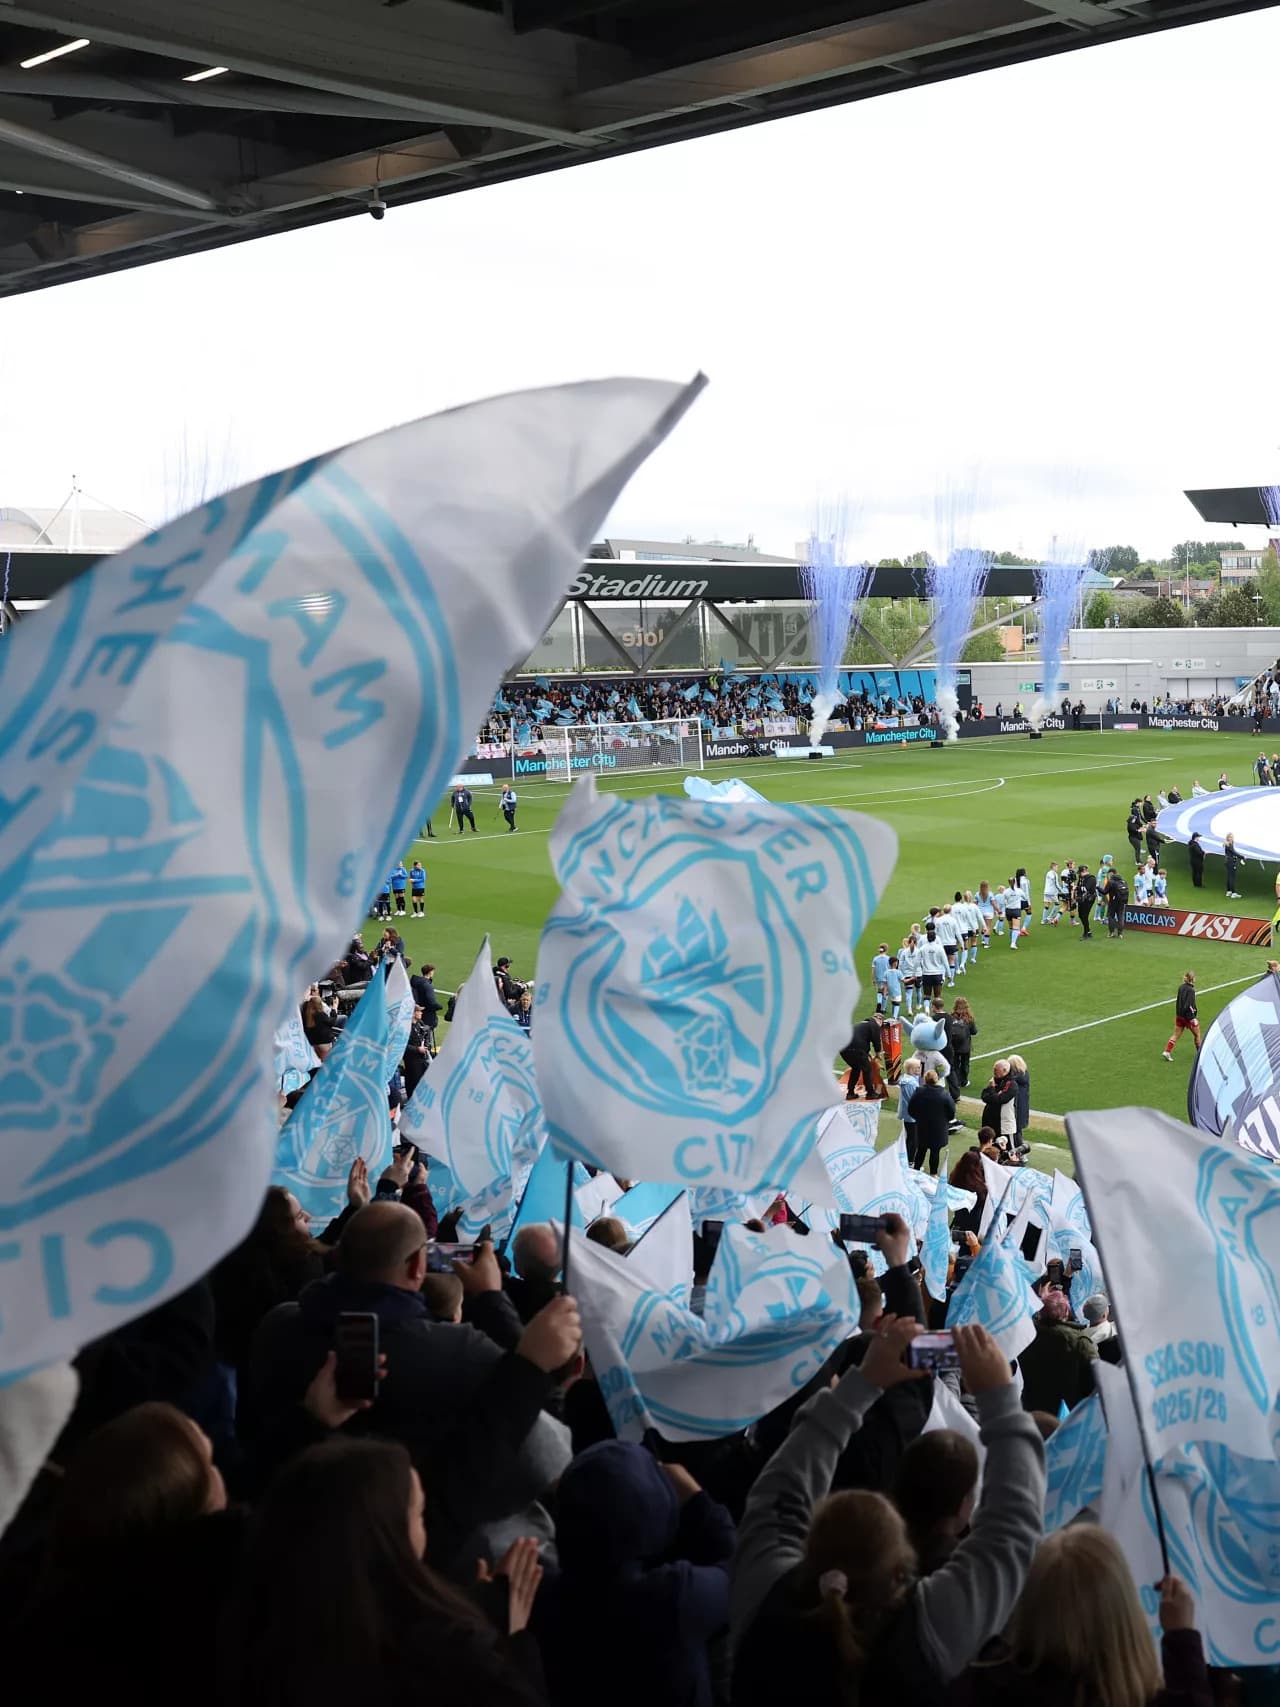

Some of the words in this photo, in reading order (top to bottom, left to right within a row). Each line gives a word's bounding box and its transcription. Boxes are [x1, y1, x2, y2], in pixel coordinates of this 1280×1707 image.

[565, 572, 709, 597] Stadium
[1045, 716, 1065, 729] City
[1149, 716, 1200, 729] Manchester
[1200, 718, 1219, 731] City
[866, 729, 919, 743] Manchester
[918, 726, 937, 740] City
[516, 755, 592, 773] Manchester
[591, 752, 616, 768] City
[1125, 911, 1176, 928] BARCLAYS
[1178, 912, 1243, 942] WSL
